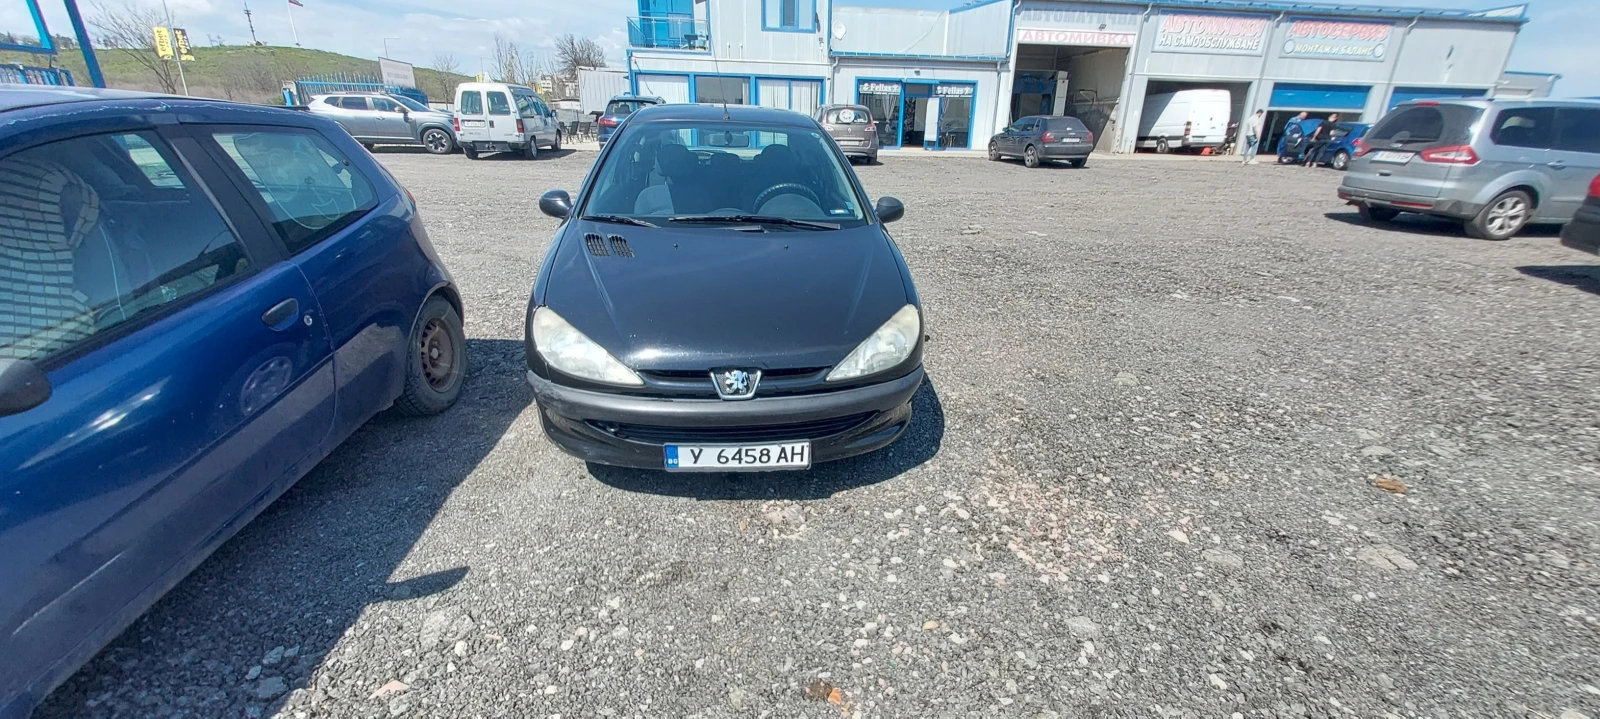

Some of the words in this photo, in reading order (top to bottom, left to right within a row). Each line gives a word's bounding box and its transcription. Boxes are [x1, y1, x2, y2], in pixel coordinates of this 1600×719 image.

[1160, 14, 1267, 38] АВТОМИВКИ
[1287, 20, 1390, 42] АВТОСЕРВИЗ
[1021, 30, 1130, 45] АВТОМИВКА
[1158, 34, 1172, 47] НА
[1173, 35, 1260, 51] САМООБСЛУЖВАНЕ
[1294, 43, 1331, 54] МОНТАЖ
[870, 83, 892, 92] Fellas
[943, 86, 964, 95] Fellas
[716, 448, 771, 465] 6458
